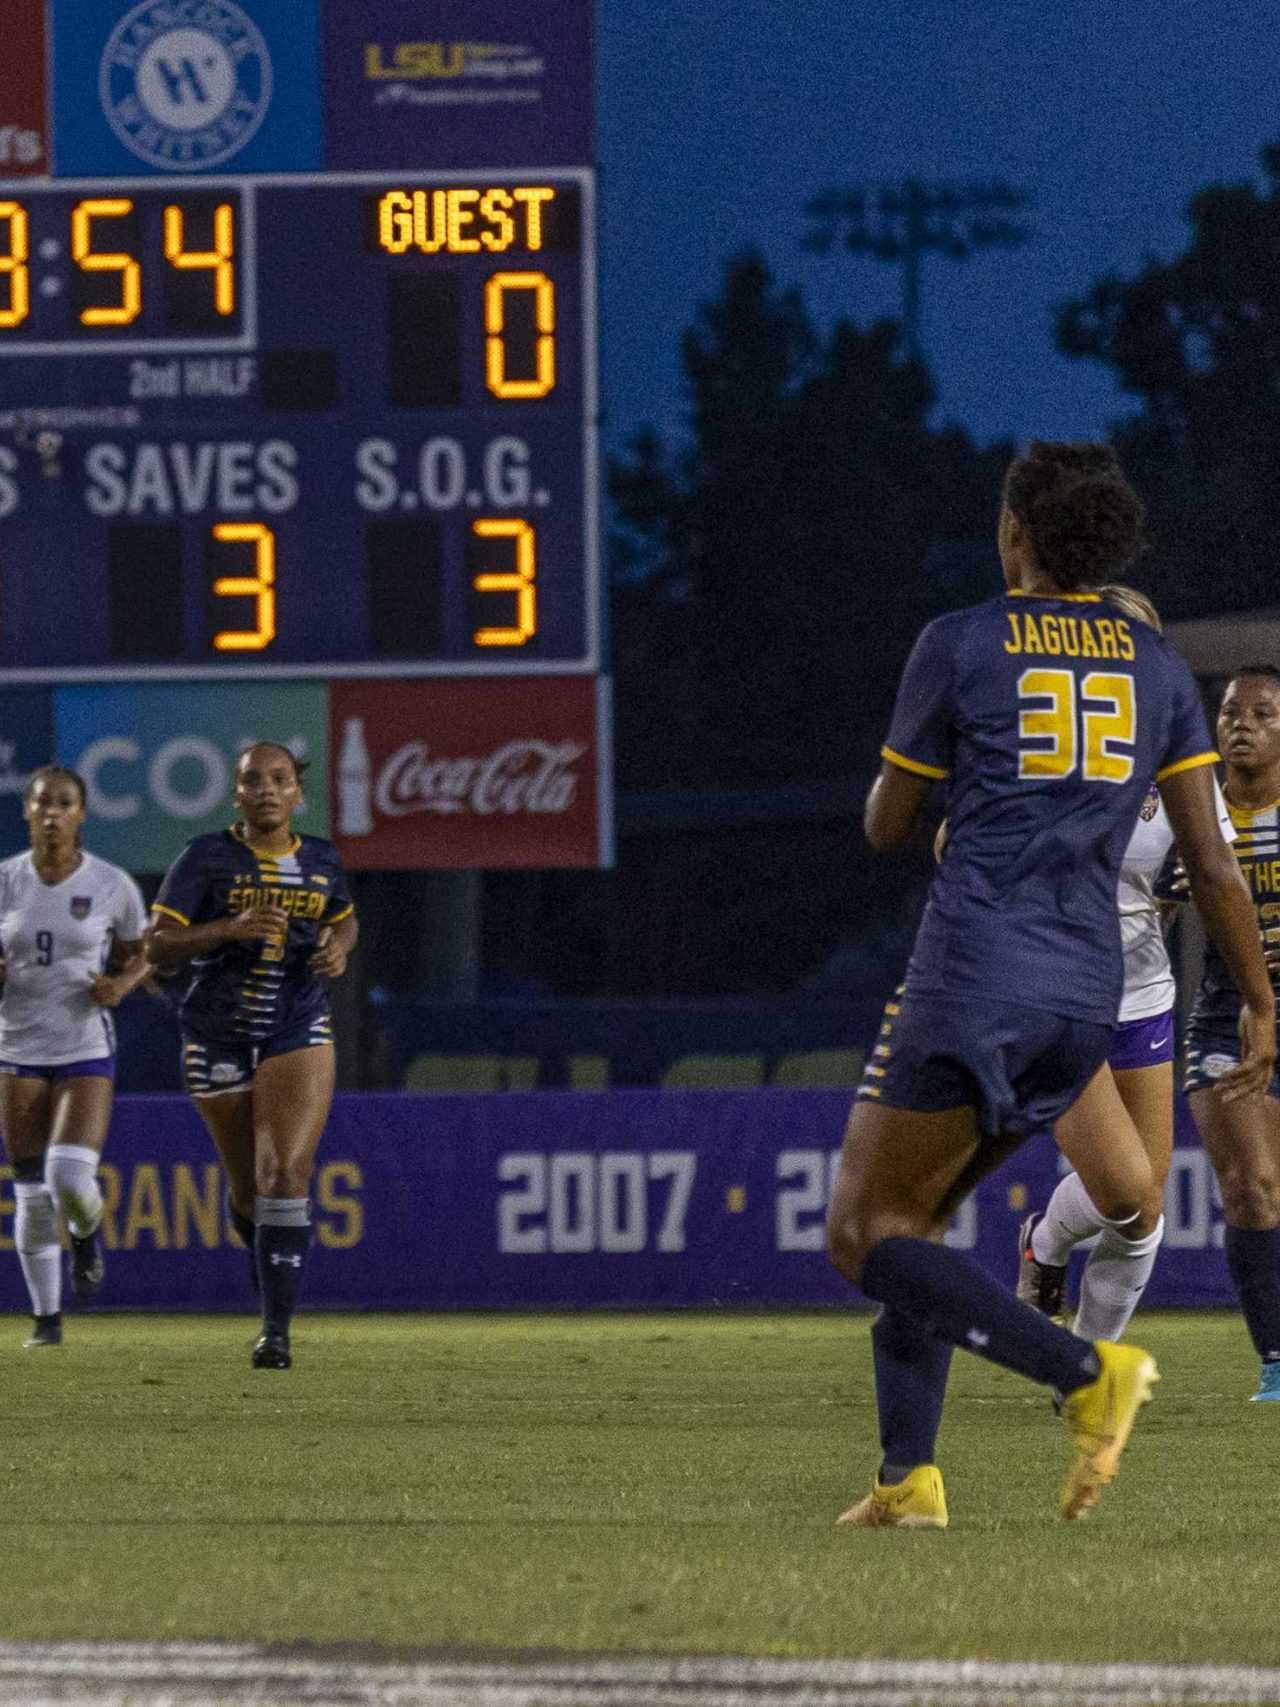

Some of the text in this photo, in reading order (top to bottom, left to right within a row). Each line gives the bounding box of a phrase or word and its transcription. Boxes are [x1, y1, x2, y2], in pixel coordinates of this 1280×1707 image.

[365, 42, 464, 79] LSU
[379, 188, 554, 254] GUEST
[484, 271, 555, 400] 0
[129, 357, 257, 398] 2nd HALF
[84, 439, 299, 516] SAVES
[355, 437, 551, 511] S.O.G.
[212, 523, 275, 650] 3
[472, 518, 536, 646] 3
[1003, 613, 1136, 661] JAGUARS
[1018, 667, 1136, 784] 32
[227, 887, 329, 919] SOUTHER
[35, 930, 54, 967] 9
[497, 1151, 698, 1254] 2007
